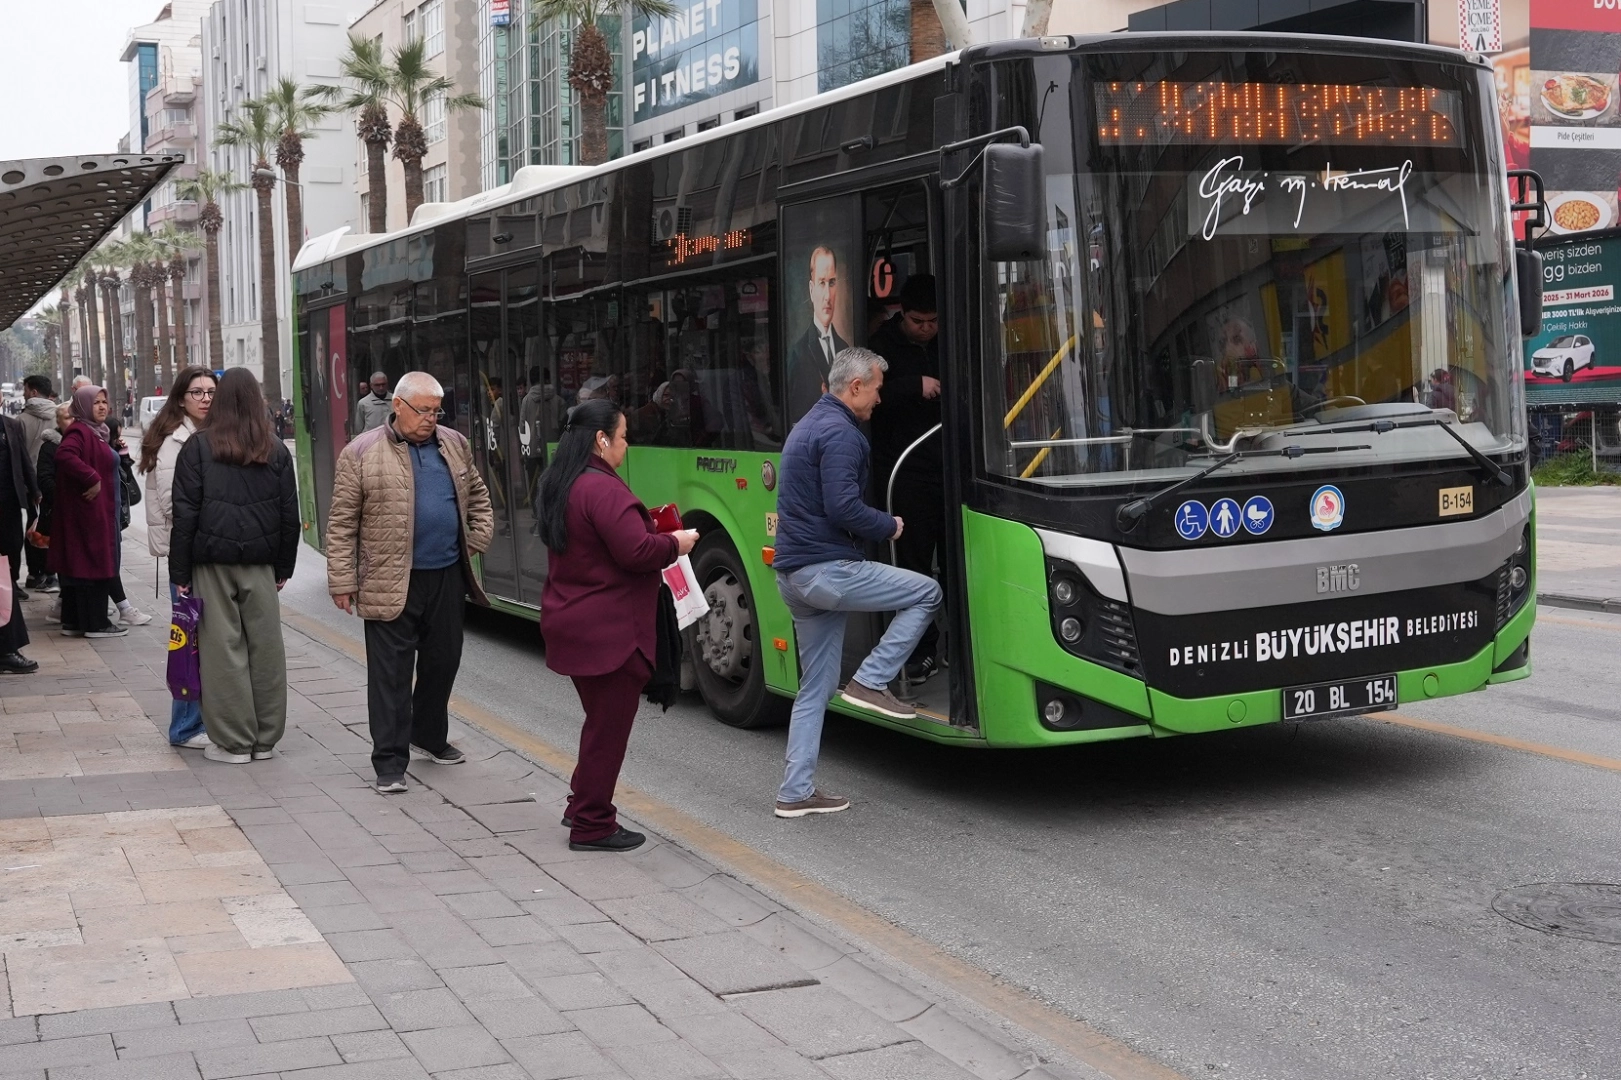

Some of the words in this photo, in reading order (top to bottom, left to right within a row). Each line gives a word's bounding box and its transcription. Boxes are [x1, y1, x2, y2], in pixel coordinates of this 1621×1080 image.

[1466, 0, 1492, 10] YEME
[1593, 0, 1621, 10] DO
[1467, 10, 1493, 27] İÇME
[632, 0, 721, 61] PLANET
[634, 46, 740, 113] FITNESS
[1557, 132, 1571, 140] Pide
[1571, 132, 1595, 142] Çeşitleri
[1567, 244, 1602, 258] sizden
[1568, 262, 1602, 275] bizden
[1543, 293, 1560, 302] 2025
[1566, 292, 1573, 300] 31
[1574, 290, 1591, 299] Mart
[1592, 288, 1610, 298] 2026
[1552, 310, 1568, 319] 3000
[1568, 320, 1588, 330] Hakkı
[1442, 492, 1472, 510] B-154
[1316, 563, 1361, 594] BMC
[1294, 689, 1316, 715] 20
[1329, 685, 1351, 710] BL
[1365, 679, 1395, 705] 154
